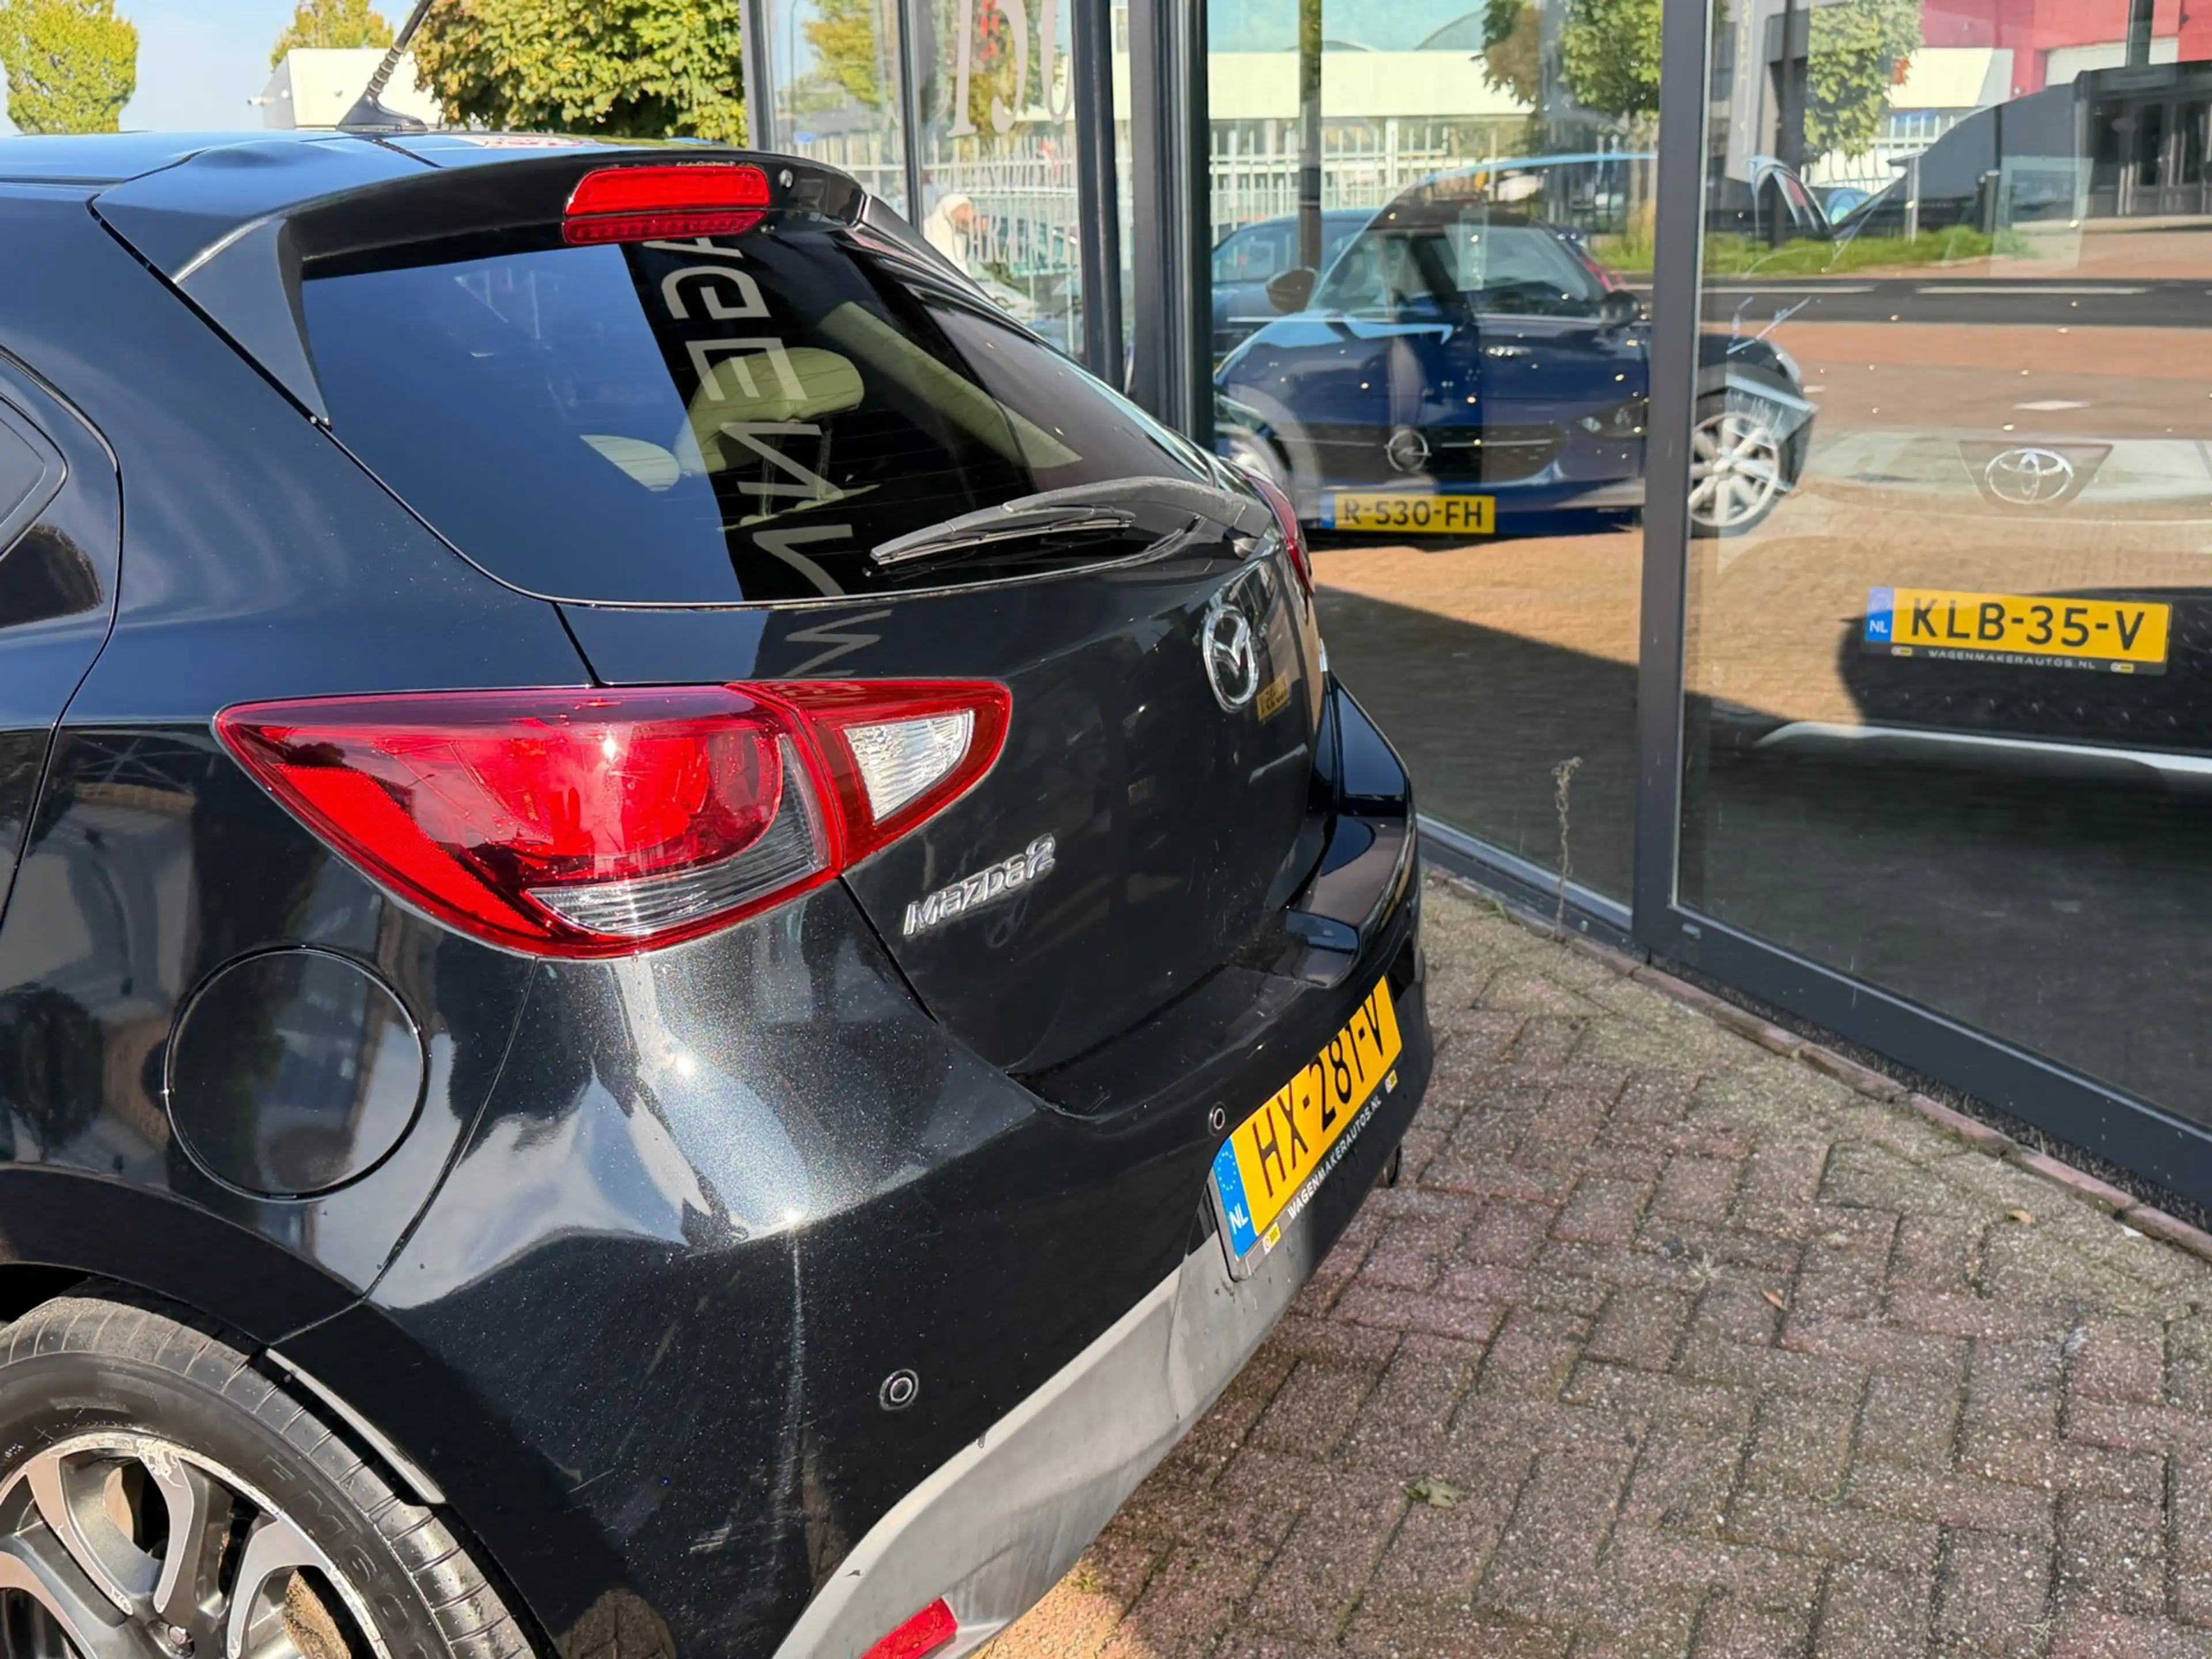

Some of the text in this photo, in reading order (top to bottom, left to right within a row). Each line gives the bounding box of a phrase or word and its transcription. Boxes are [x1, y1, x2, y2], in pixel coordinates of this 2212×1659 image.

[1343, 498, 1482, 528] R-530-FH
[1869, 619, 1889, 634] NL
[1911, 597, 2145, 652] KLB-35-V
[1252, 990, 1384, 1199] HX-281-V
[1287, 1095, 1382, 1220] WAGENMAKERAUTOS.NL
[1228, 1203, 1249, 1235] NL
